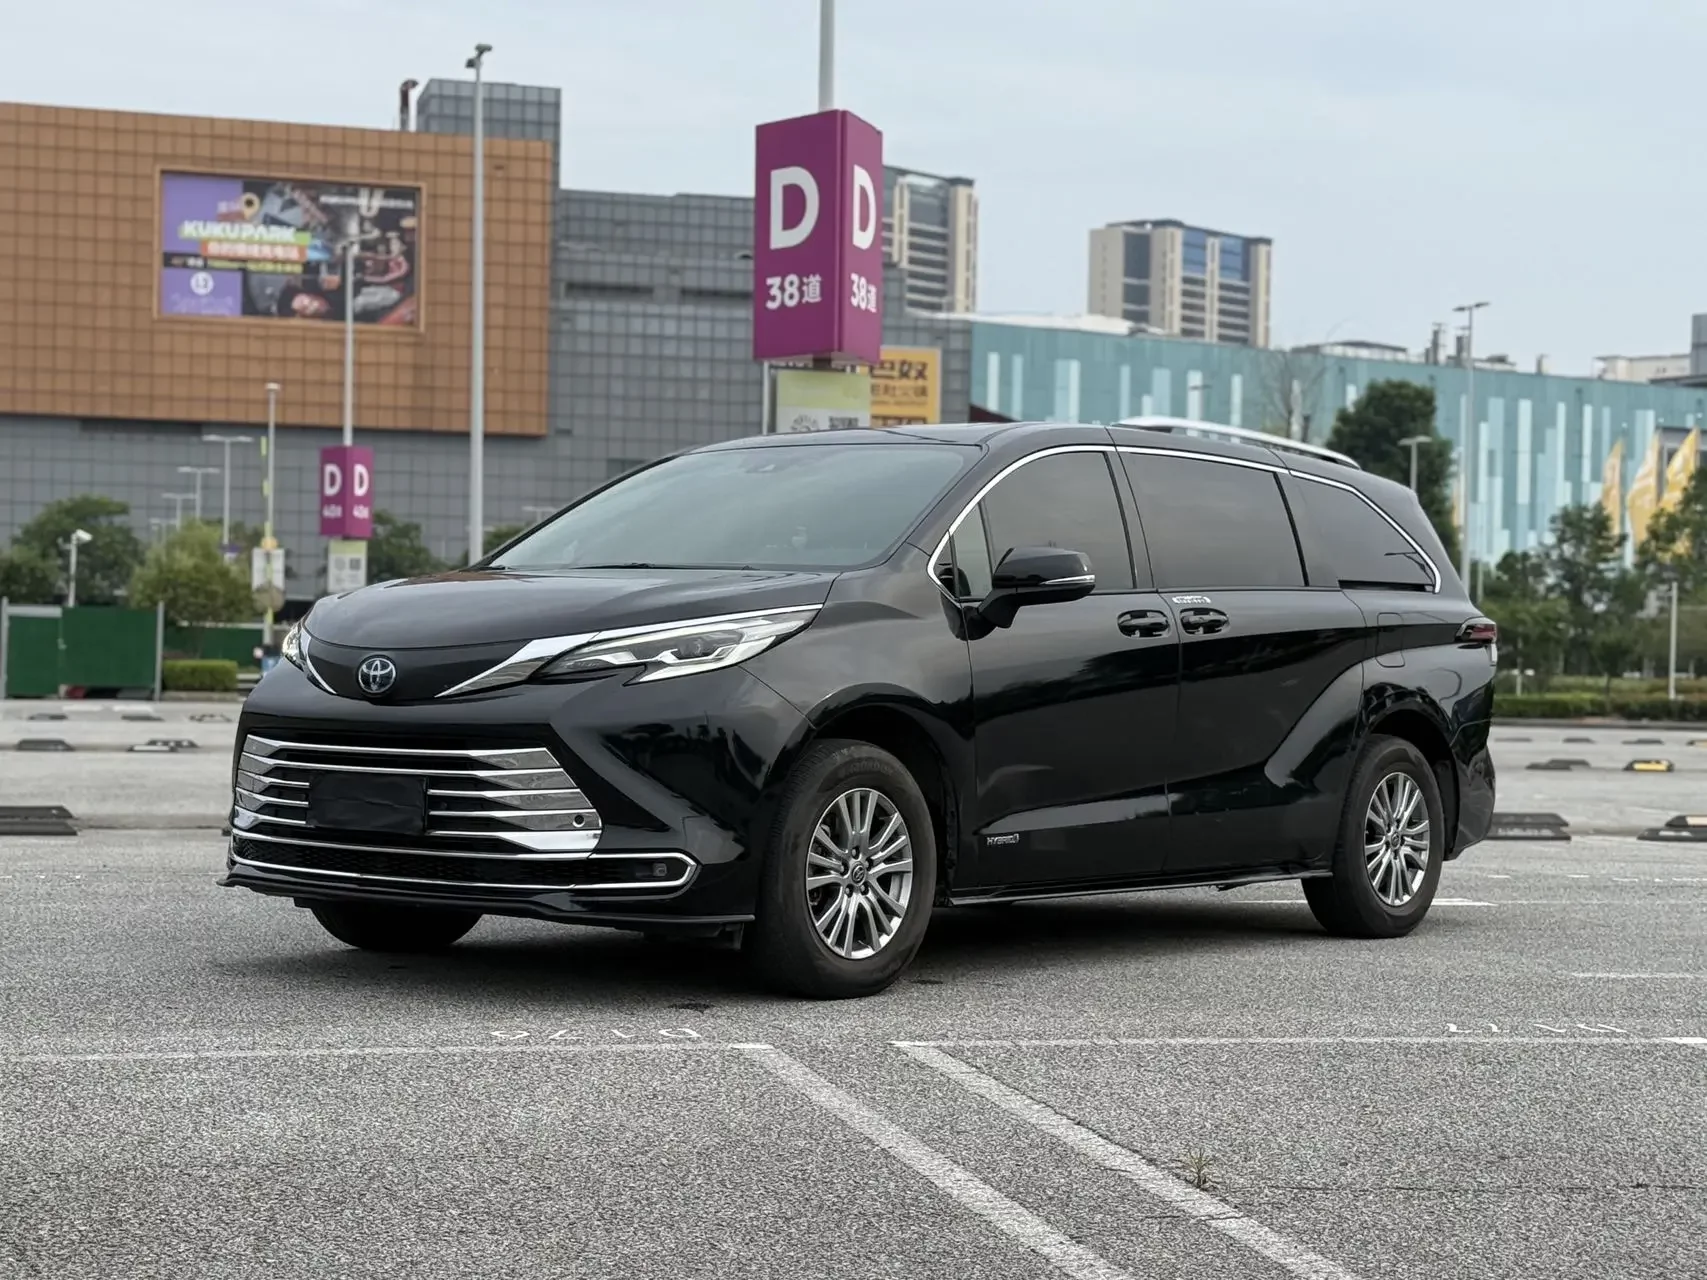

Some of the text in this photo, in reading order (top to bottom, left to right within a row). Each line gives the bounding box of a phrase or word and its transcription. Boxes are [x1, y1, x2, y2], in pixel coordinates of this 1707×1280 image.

[770, 166, 820, 250] D
[853, 164, 877, 250] D
[766, 273, 822, 309] 38道
[850, 273, 877, 313] 38道
[324, 463, 342, 496] D
[353, 463, 370, 496] D
